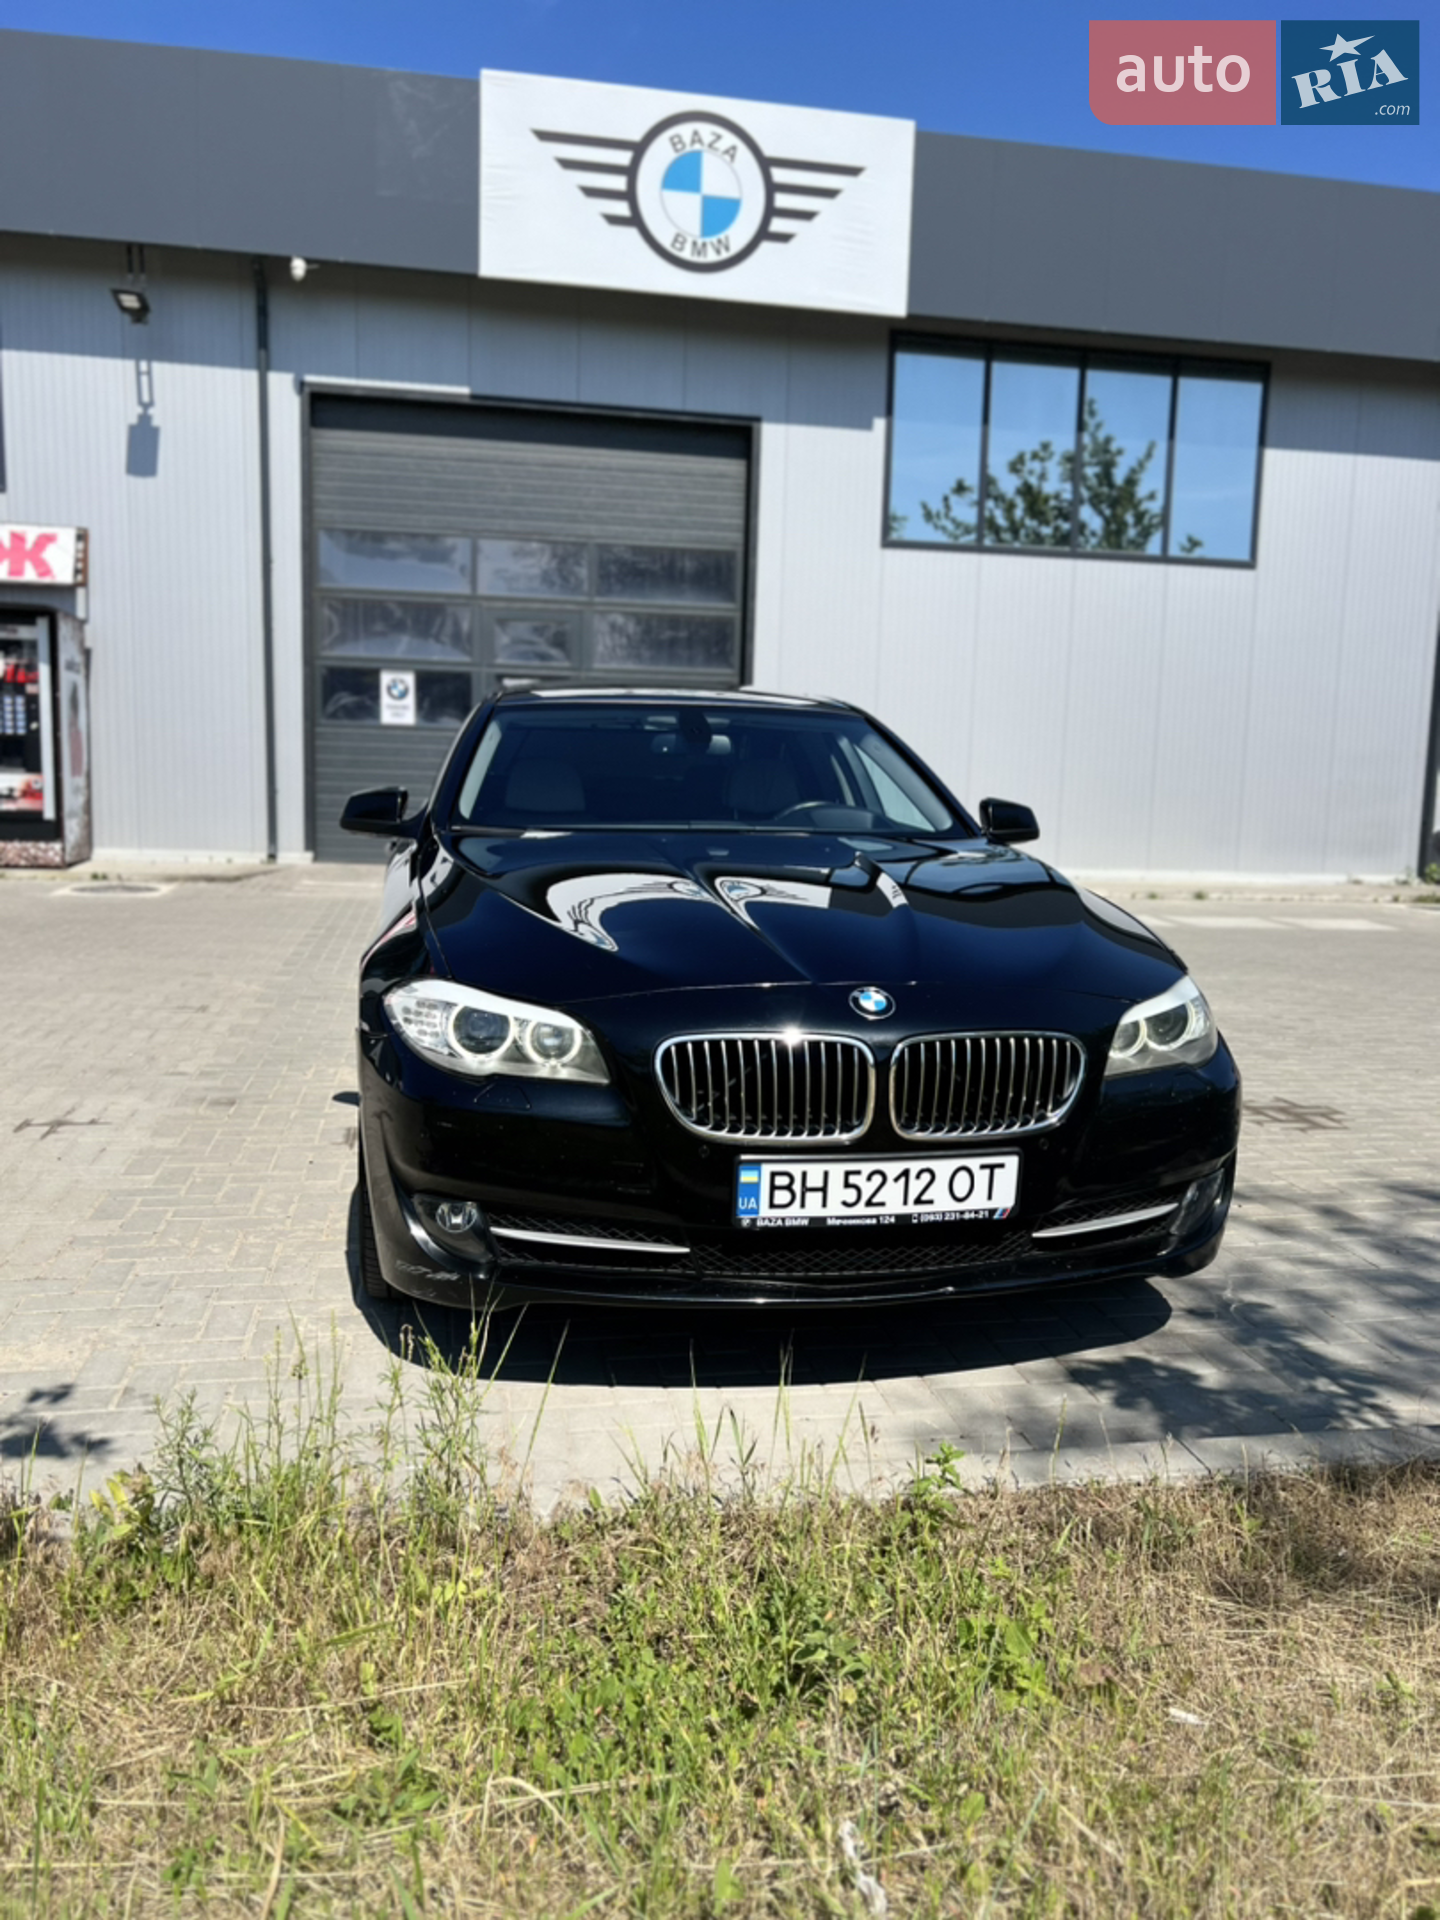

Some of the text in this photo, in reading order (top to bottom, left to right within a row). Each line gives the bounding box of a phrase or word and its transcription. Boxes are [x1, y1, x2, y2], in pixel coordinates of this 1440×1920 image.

[669, 129, 739, 163] BAZA
[670, 232, 732, 259] BMW
[768, 1163, 1006, 1210] BH 5212 OT
[738, 1198, 758, 1210] UA
[785, 1217, 809, 1226] BMW
[879, 1215, 896, 1224] 124
